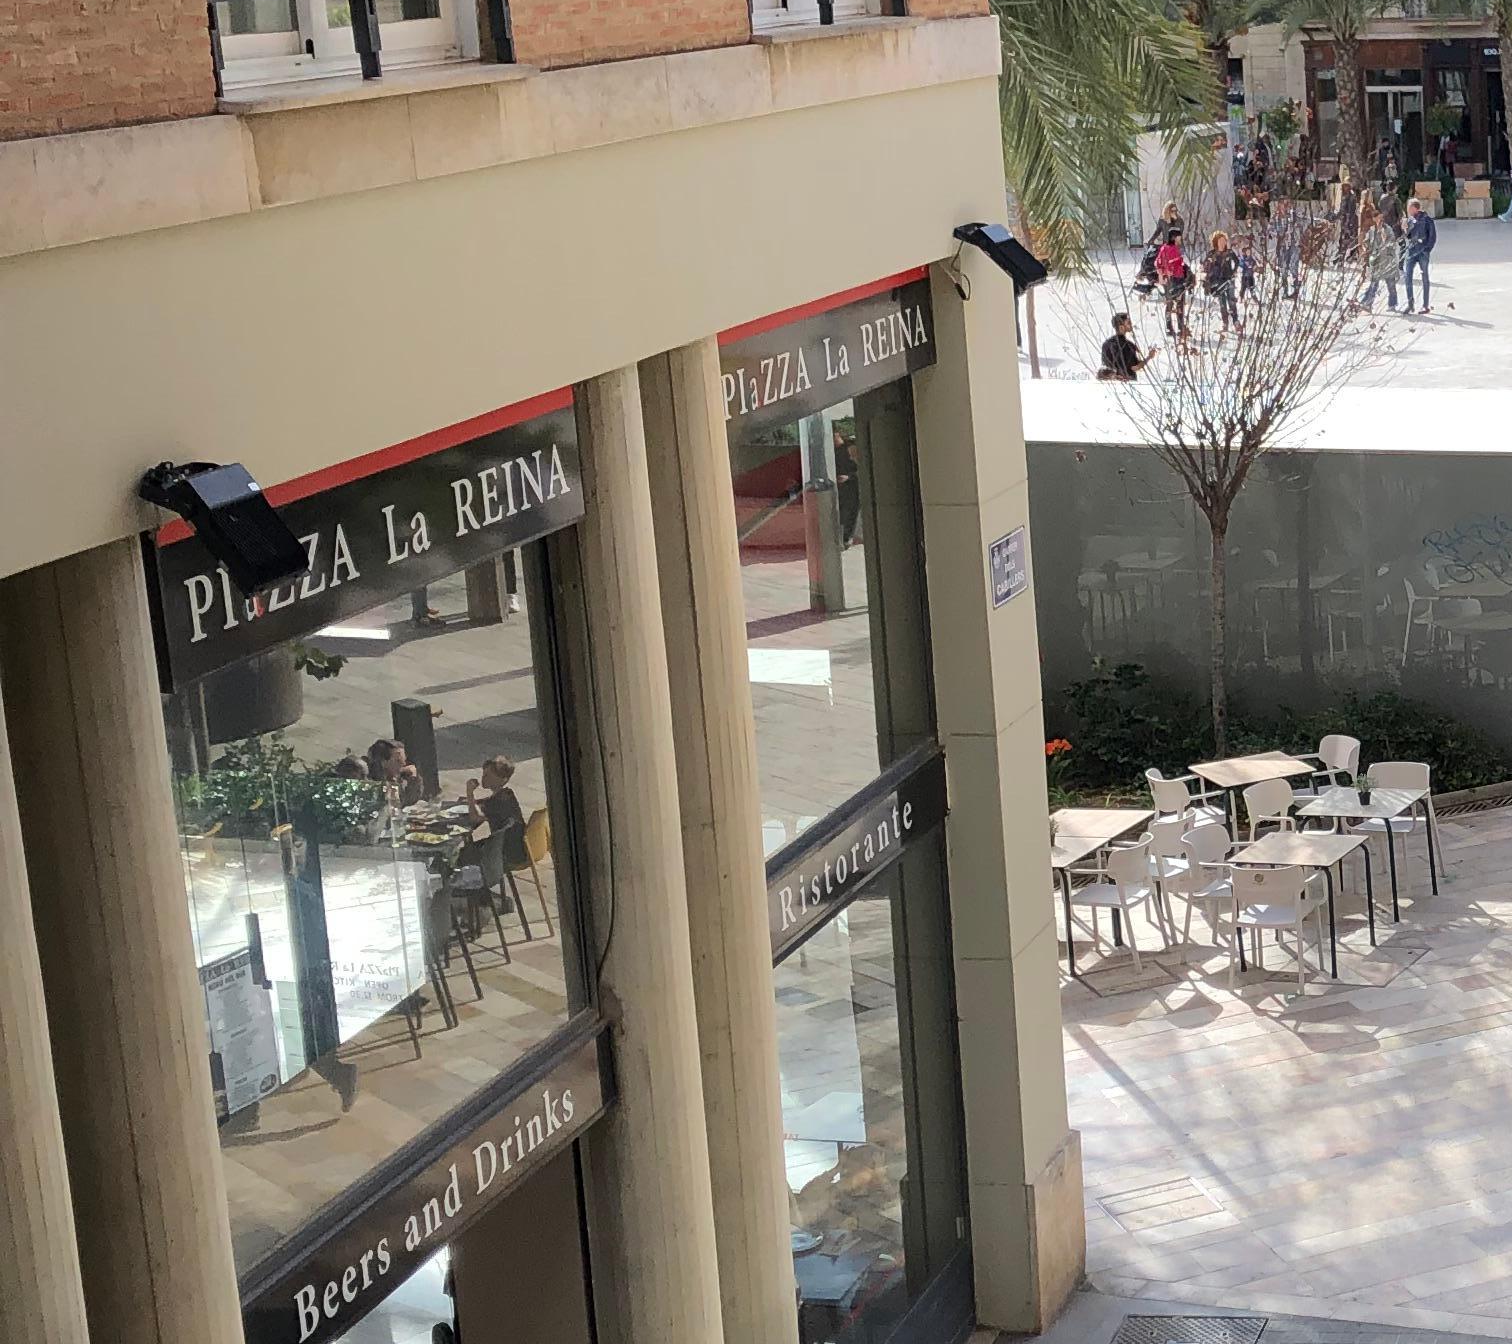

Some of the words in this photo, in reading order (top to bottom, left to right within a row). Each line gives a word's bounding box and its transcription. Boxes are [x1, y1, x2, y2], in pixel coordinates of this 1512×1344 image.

[823, 336, 850, 383] La
[860, 304, 928, 367] REINA
[381, 503, 431, 565] La
[450, 443, 571, 538] REINA
[777, 800, 914, 932] Ristorante
[293, 1236, 392, 1344] Beers
[403, 1163, 464, 1253] and
[471, 1088, 576, 1197] Drinks
